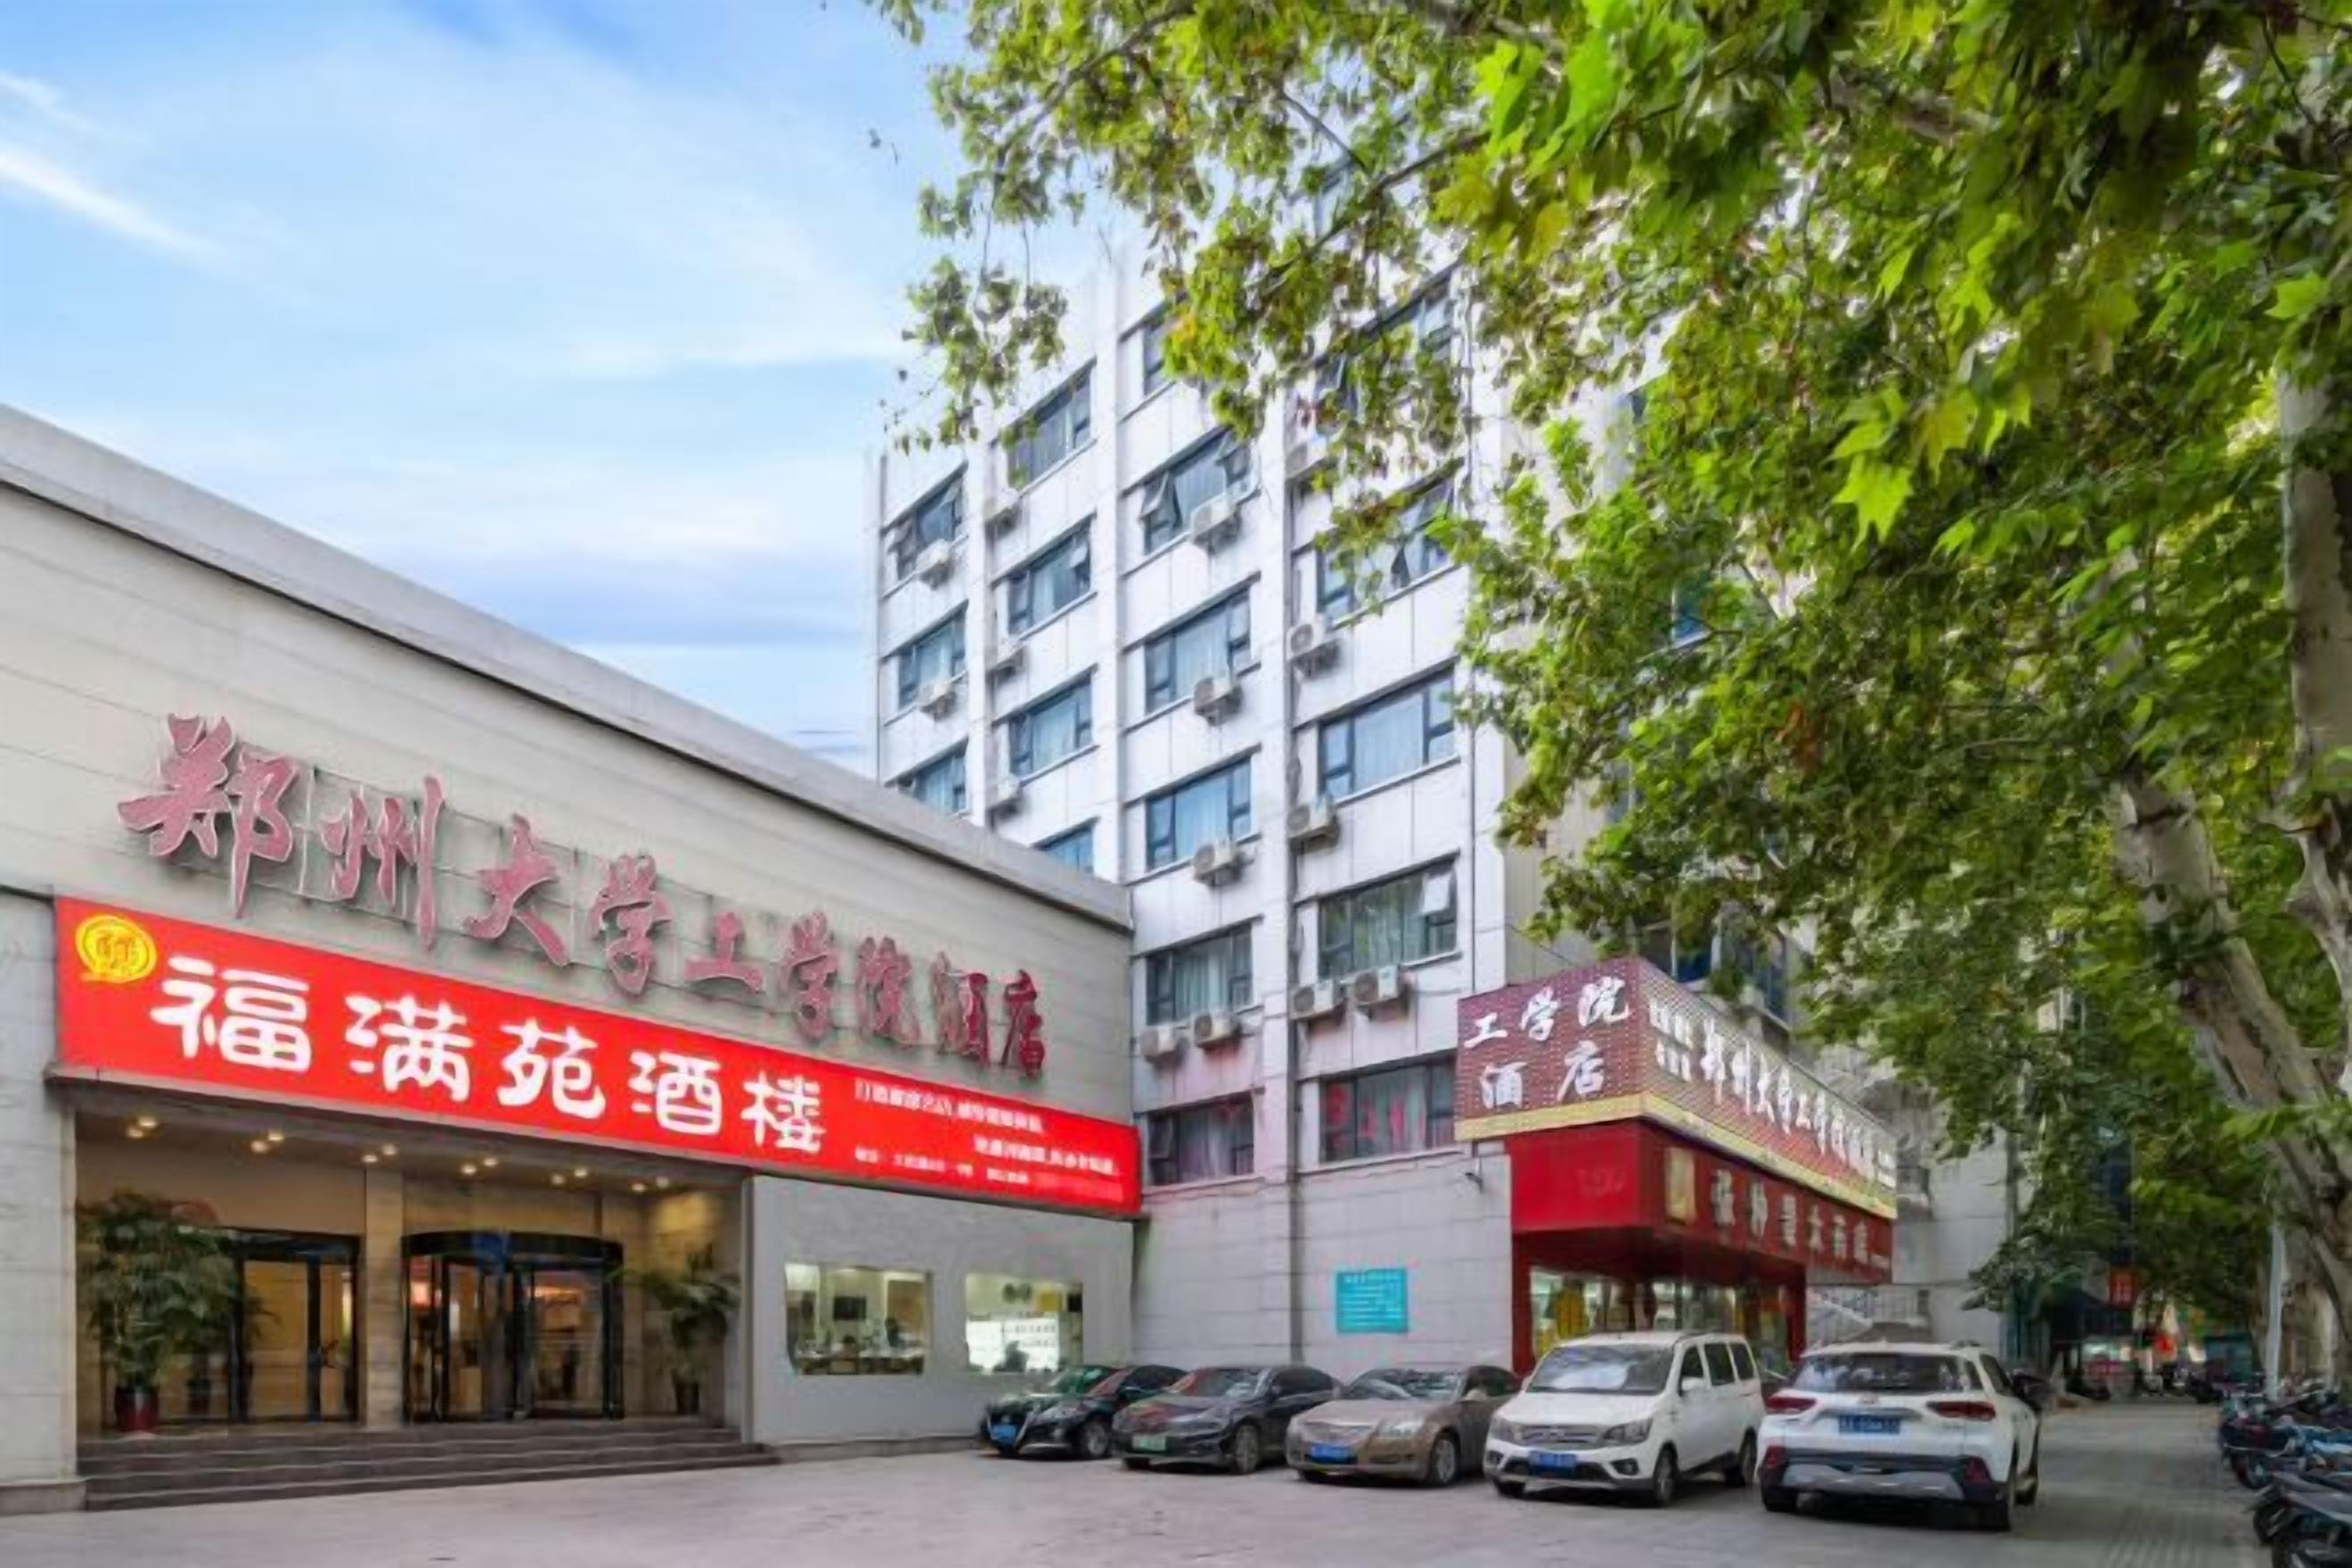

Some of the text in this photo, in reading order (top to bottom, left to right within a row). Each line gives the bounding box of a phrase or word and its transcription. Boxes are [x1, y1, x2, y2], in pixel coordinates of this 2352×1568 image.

[118, 714, 1045, 1078] 郑州大学工学院酒店
[149, 955, 827, 1154] 福满苑酒楼
[1464, 976, 1630, 1048] 工学院
[1480, 1040, 1605, 1110] 酒店
